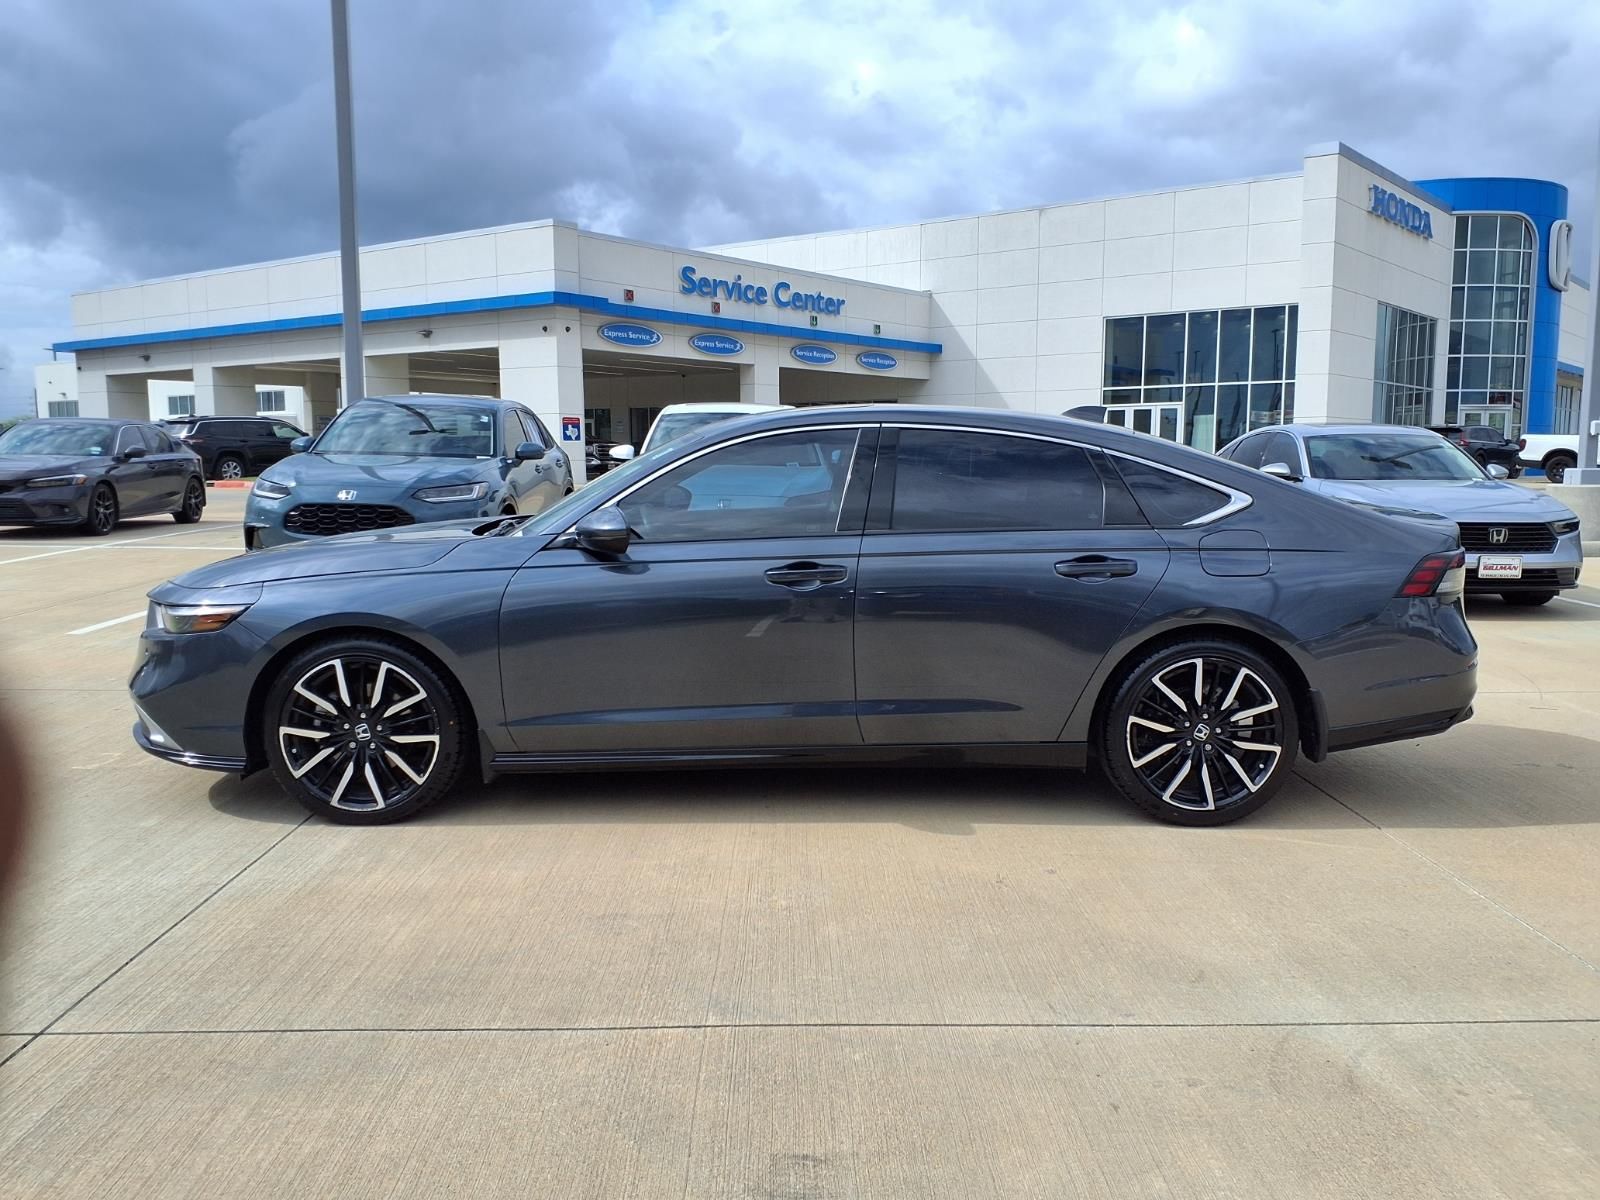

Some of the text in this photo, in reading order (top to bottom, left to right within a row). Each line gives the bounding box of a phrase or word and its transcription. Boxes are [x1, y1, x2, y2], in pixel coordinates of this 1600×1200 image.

[1368, 184, 1433, 239] HONDA
[680, 266, 846, 316] Service Center
[603, 328, 651, 341] Express Service
[694, 339, 734, 350] Express Service
[813, 351, 834, 360] Reception
[877, 357, 895, 365] Reception
